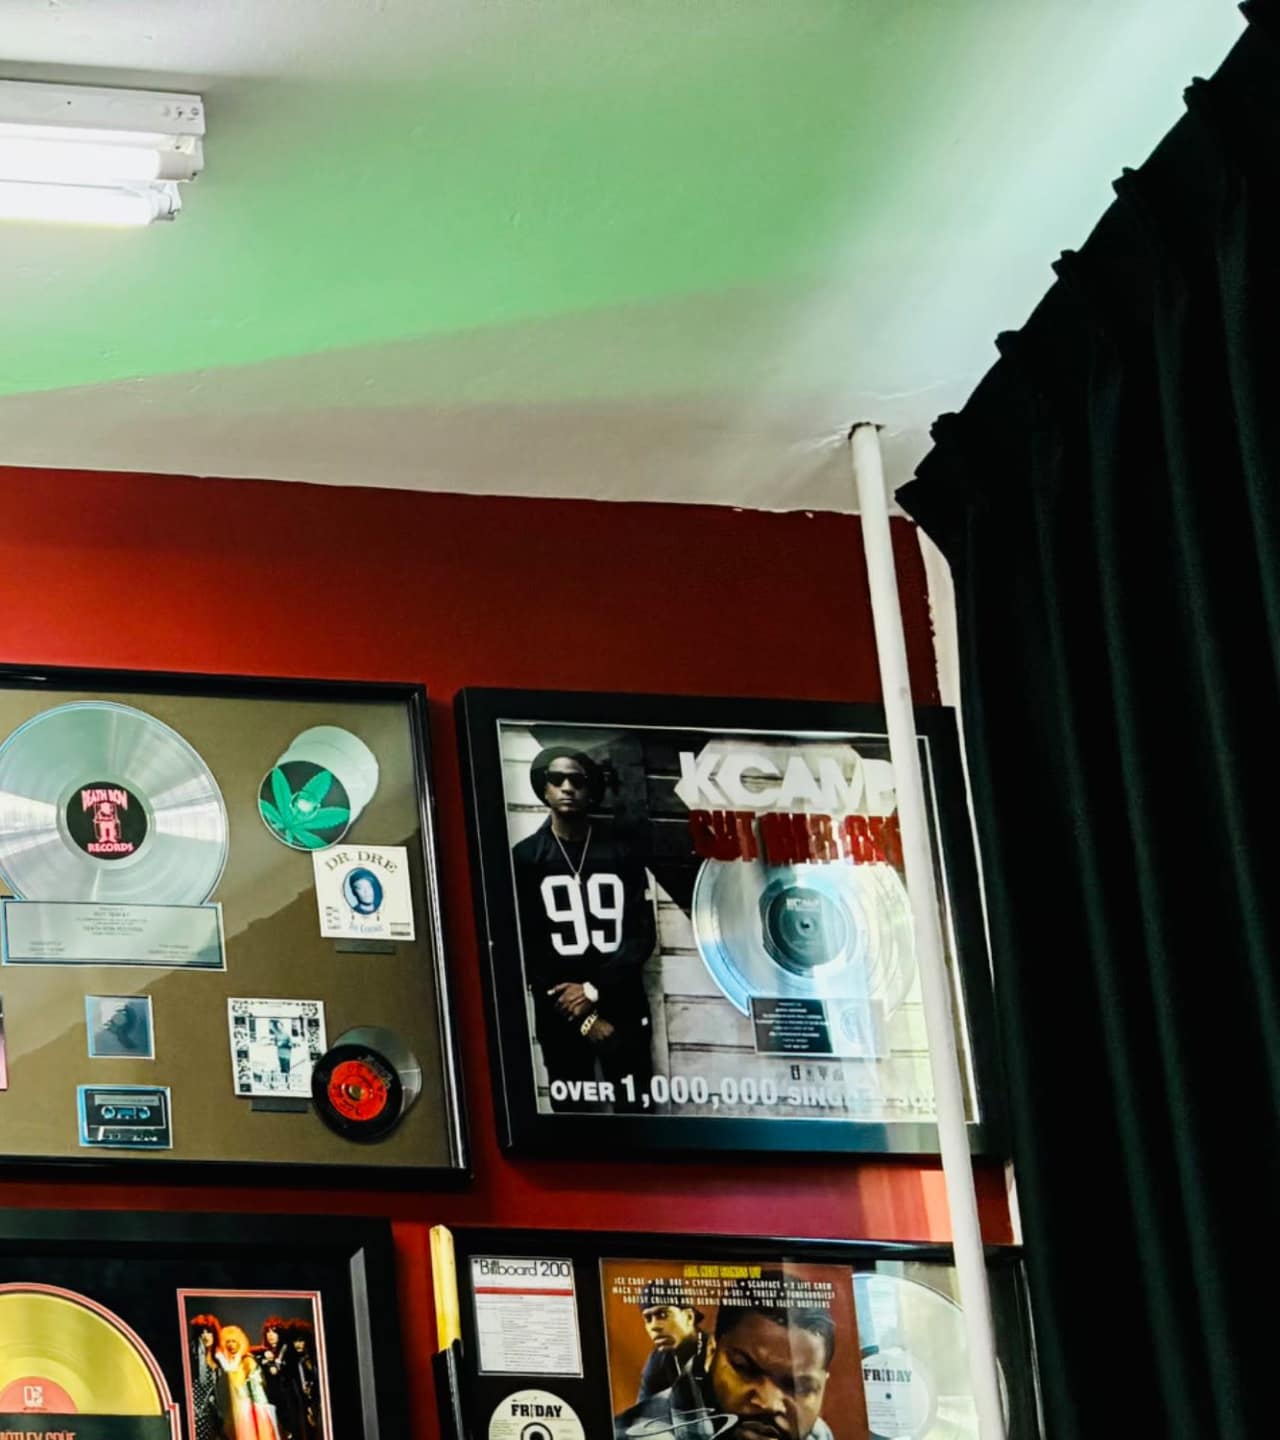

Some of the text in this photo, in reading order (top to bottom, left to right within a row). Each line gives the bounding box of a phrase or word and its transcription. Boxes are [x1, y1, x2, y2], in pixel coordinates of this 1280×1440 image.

[87, 842, 134, 853] RECORDS
[357, 850, 398, 874] DRE
[540, 873, 626, 957] 99
[550, 1074, 780, 1110] OVER 1,000,000
[479, 1259, 571, 1278] Billboard 200
[863, 1367, 913, 1383] FRIDAY
[511, 1403, 563, 1419] FRIDAY
